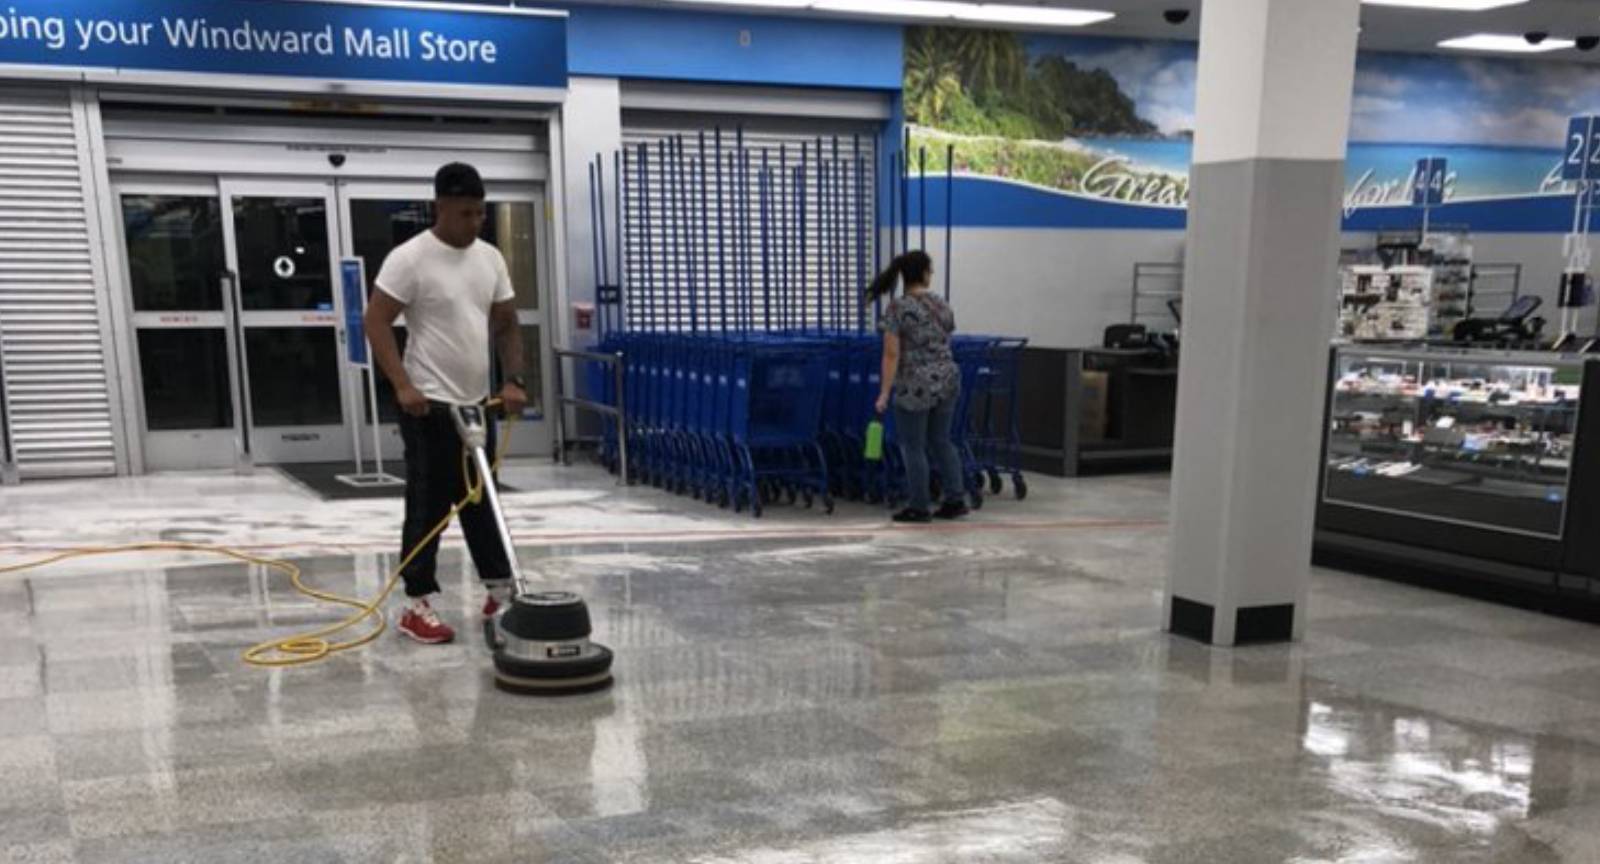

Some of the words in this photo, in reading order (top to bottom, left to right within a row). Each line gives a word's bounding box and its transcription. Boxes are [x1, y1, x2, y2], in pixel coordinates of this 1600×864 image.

[75, 19, 152, 50] your
[161, 16, 333, 55] Windward
[344, 27, 410, 59] Mall
[420, 31, 497, 63] Store
[1568, 133, 1584, 164] 2
[1430, 169, 1441, 191] 4
